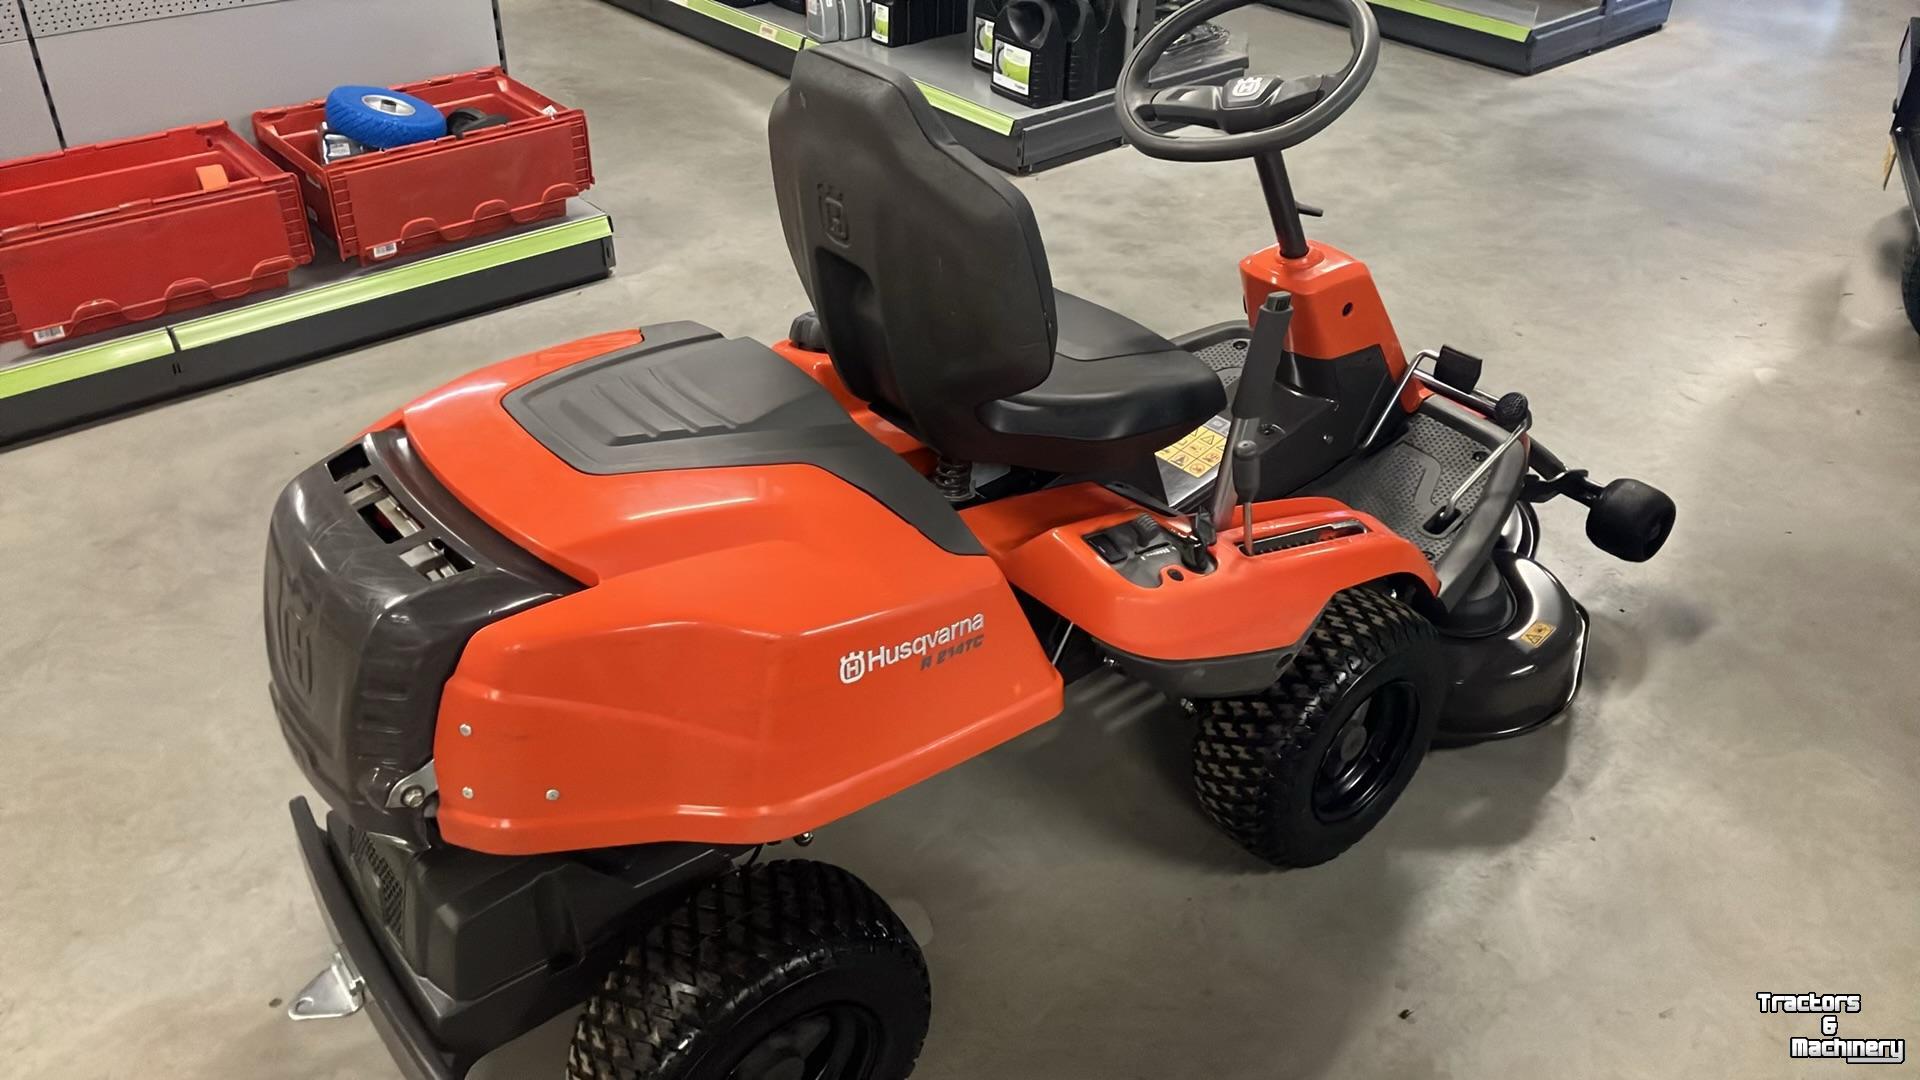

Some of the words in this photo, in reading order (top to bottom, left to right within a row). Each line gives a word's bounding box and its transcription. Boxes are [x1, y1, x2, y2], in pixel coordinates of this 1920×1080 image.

[867, 612, 985, 673] Husqvarna
[920, 655, 932, 671] R
[936, 634, 985, 665] 214TC
